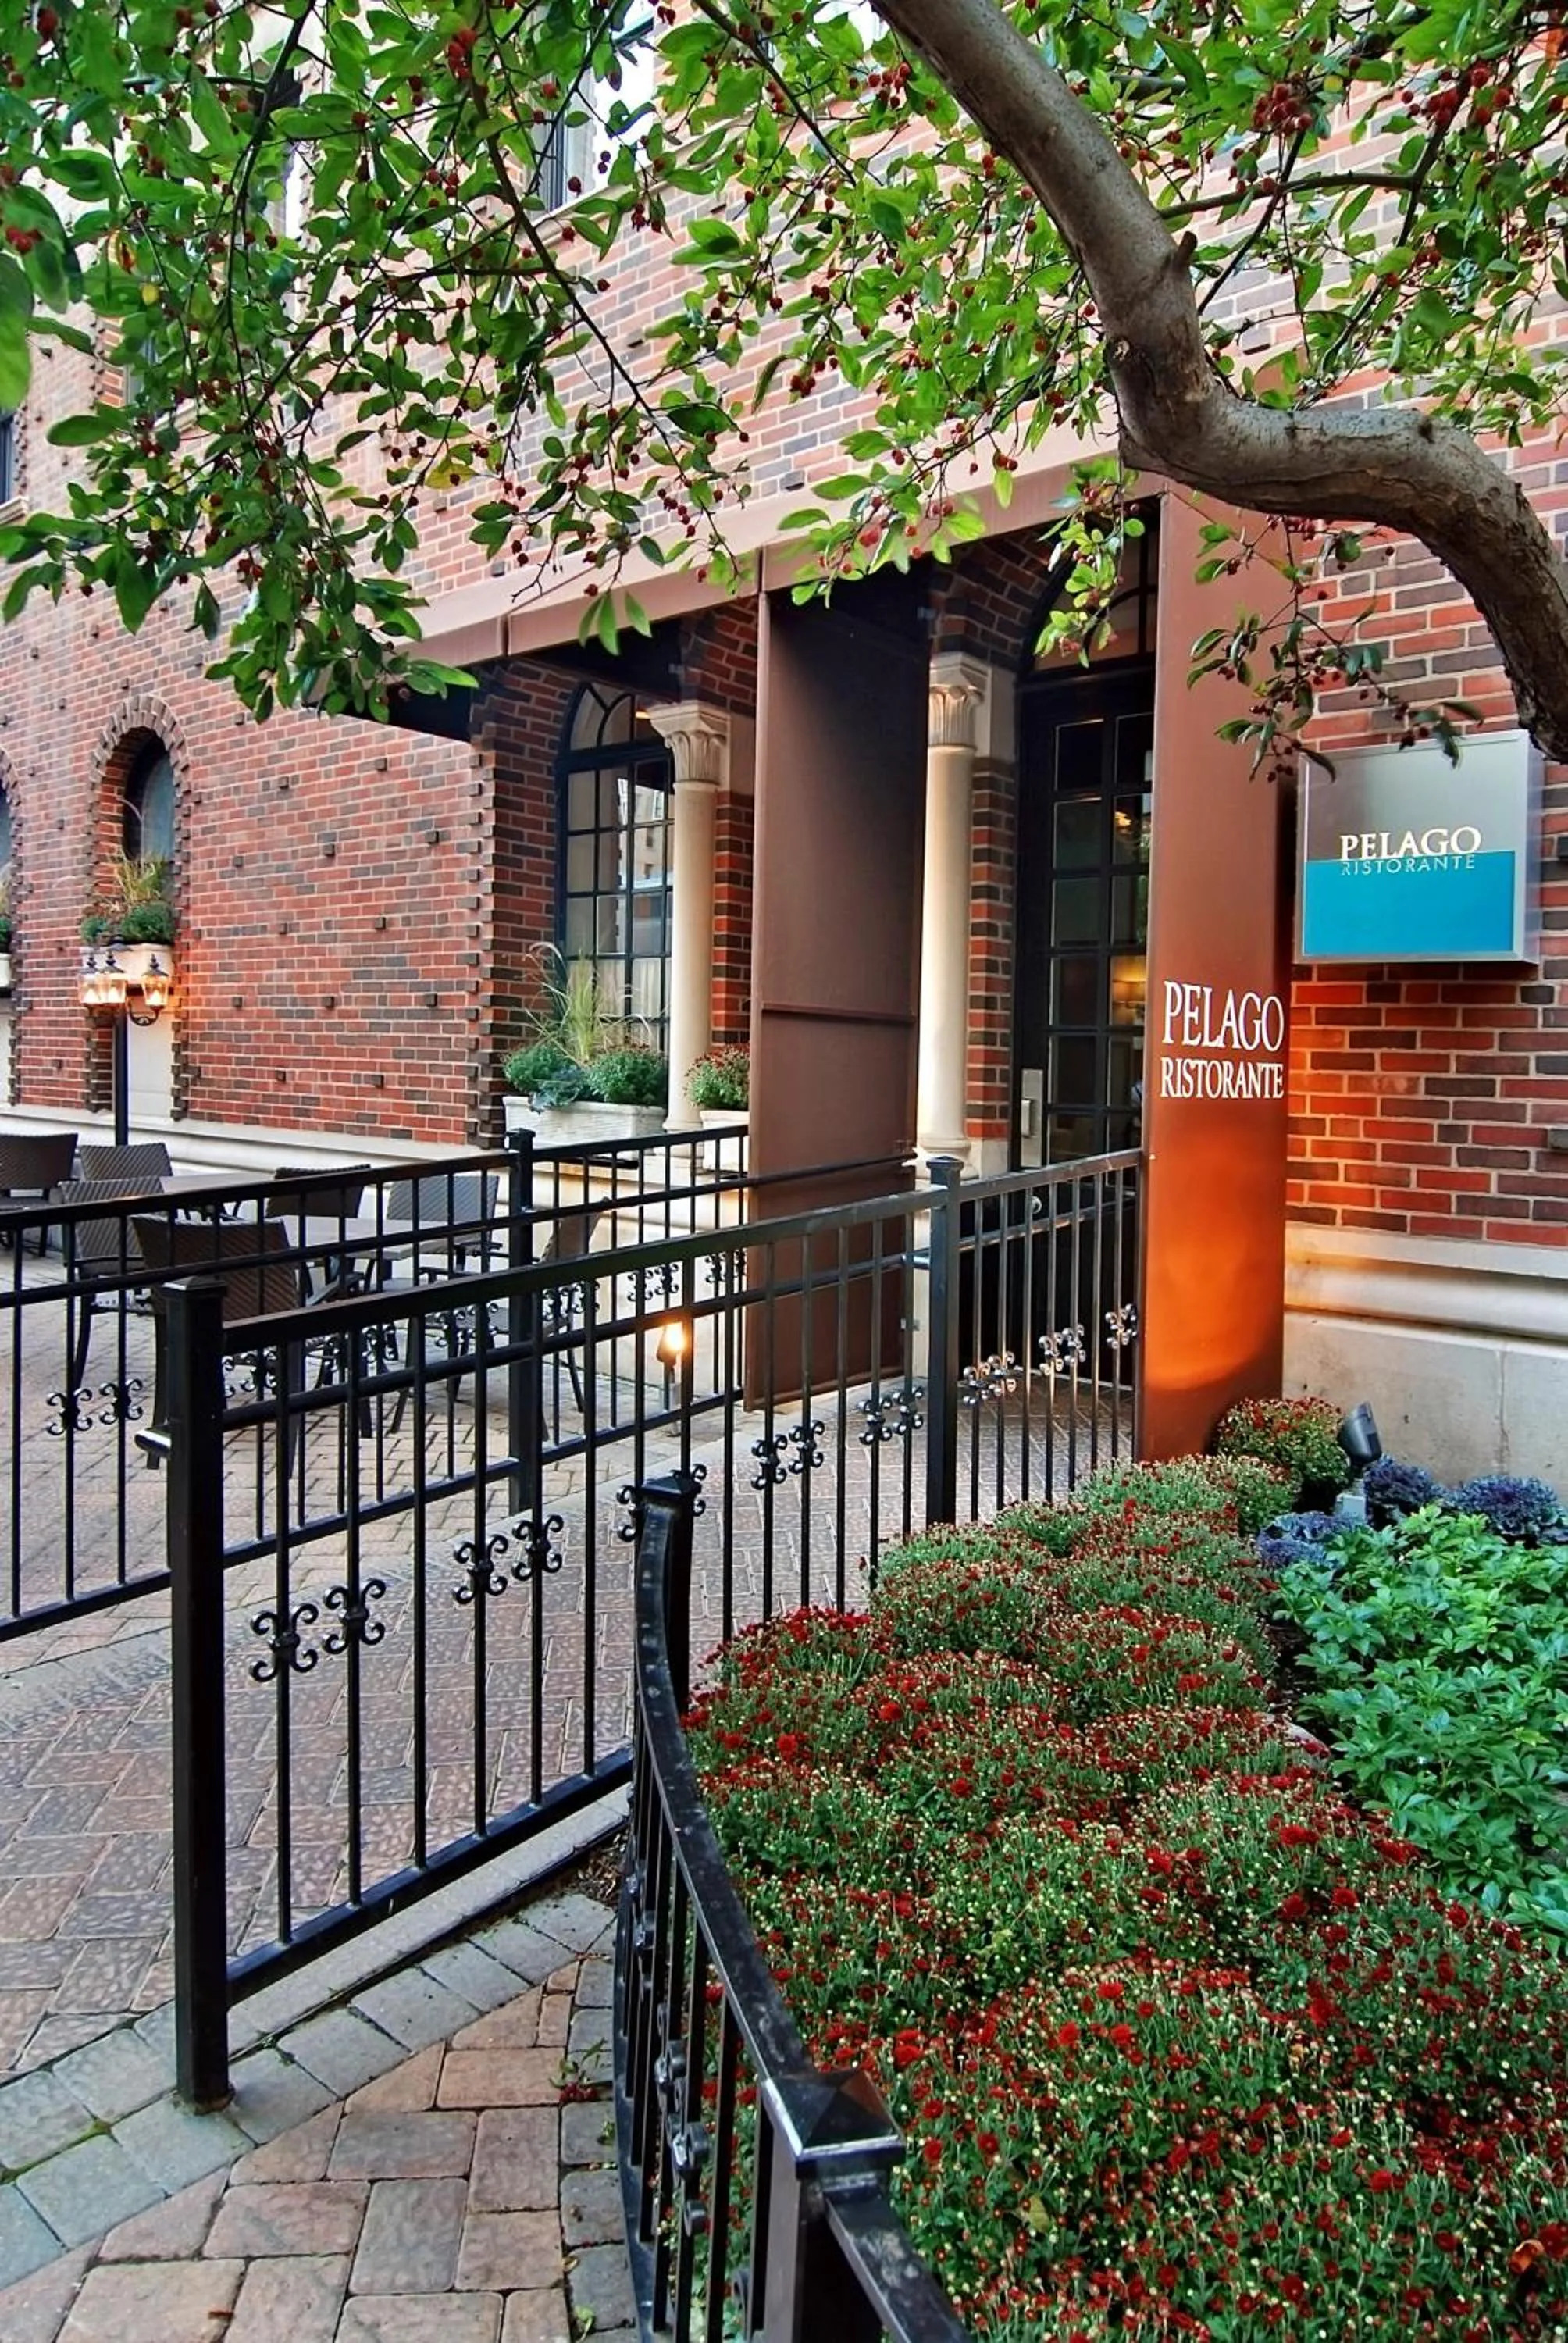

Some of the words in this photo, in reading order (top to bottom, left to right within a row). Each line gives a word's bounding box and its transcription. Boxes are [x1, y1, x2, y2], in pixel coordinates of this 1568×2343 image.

[1339, 826, 1481, 861] PELAGO
[1341, 855, 1475, 876] RISTORANTE
[1162, 980, 1285, 1052] PELAGO
[1160, 1057, 1285, 1099] RISTORANTE
